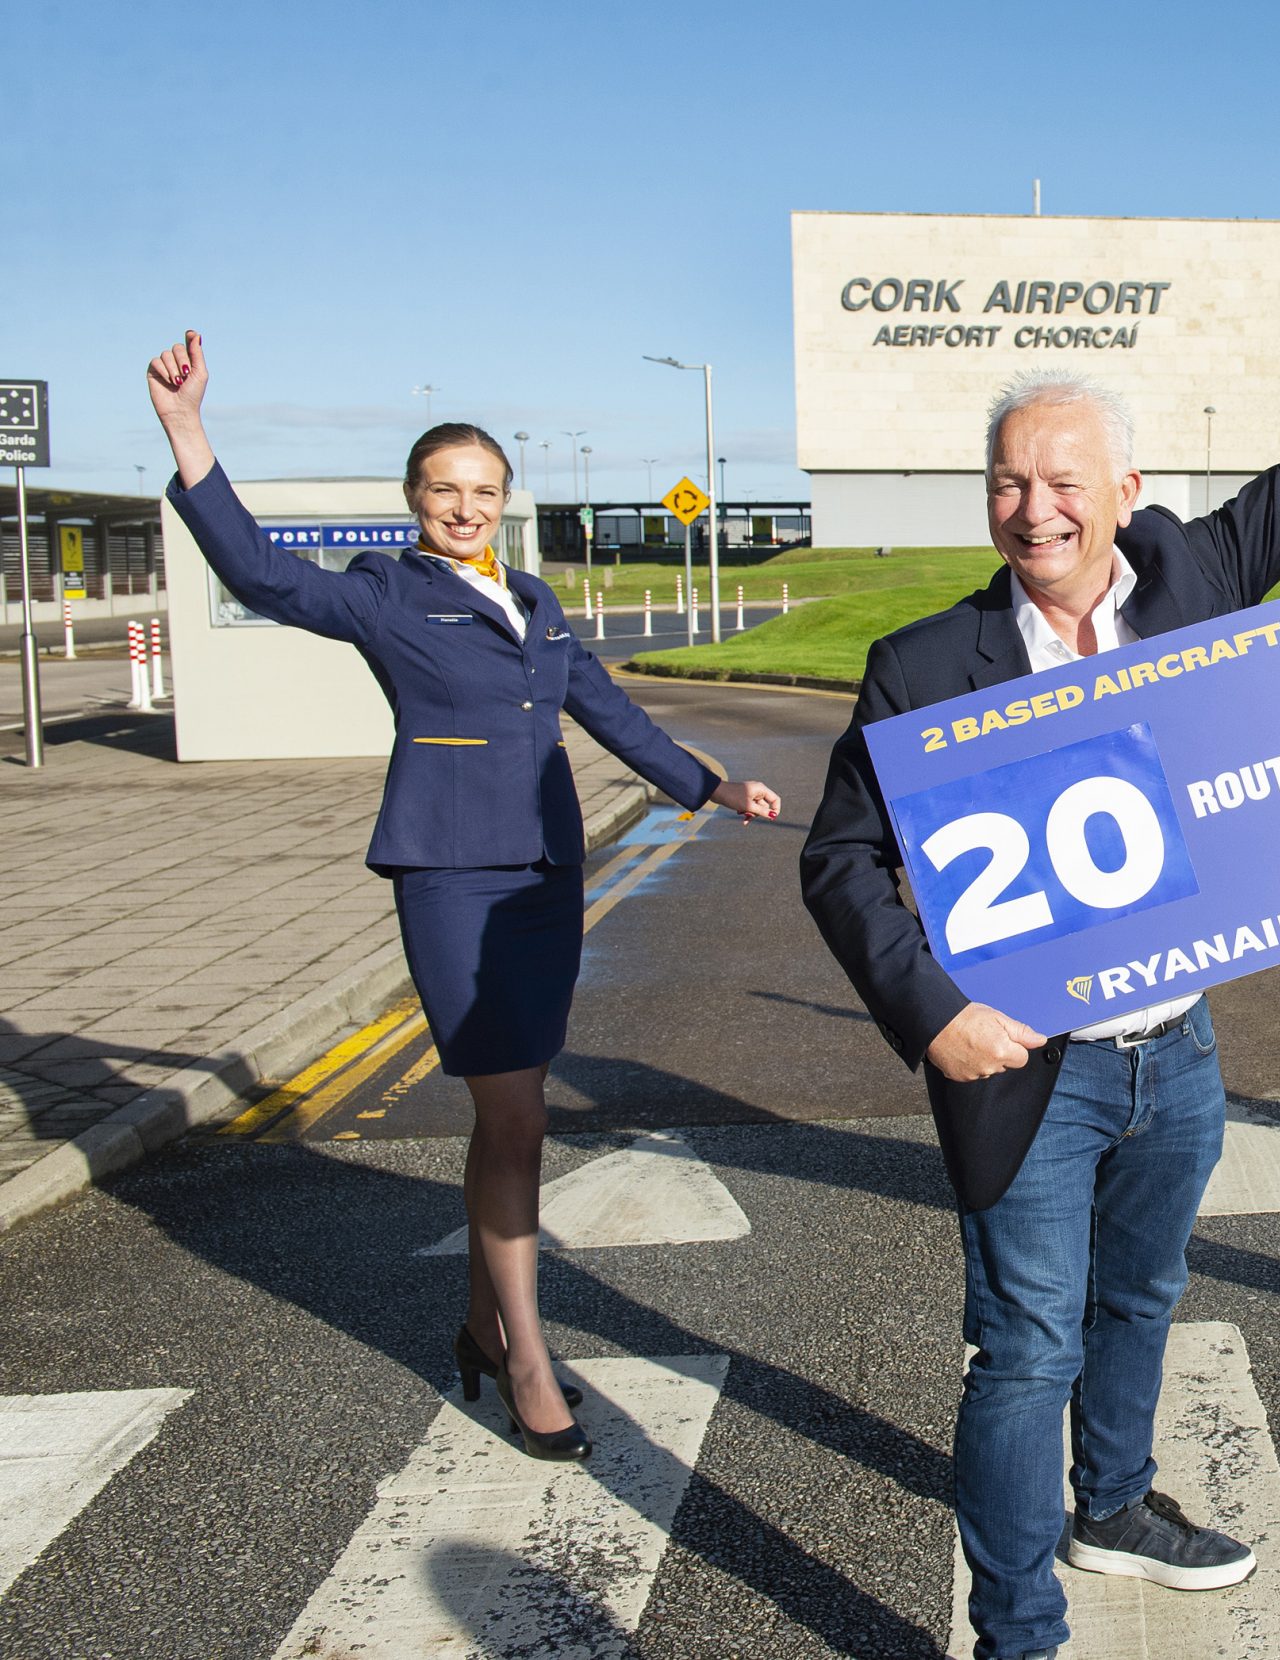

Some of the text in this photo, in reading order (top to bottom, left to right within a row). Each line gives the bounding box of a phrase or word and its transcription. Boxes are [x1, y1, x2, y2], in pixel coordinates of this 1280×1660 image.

[841, 277, 1172, 315] CORK AIRPORT
[872, 321, 1141, 349] AERFORT CHORCAÍ
[0, 433, 36, 446] Garda
[0, 449, 36, 461] Police
[333, 530, 405, 542] POLICE
[920, 727, 947, 753] 2
[951, 684, 1085, 744] BASED
[920, 775, 1165, 955] 20
